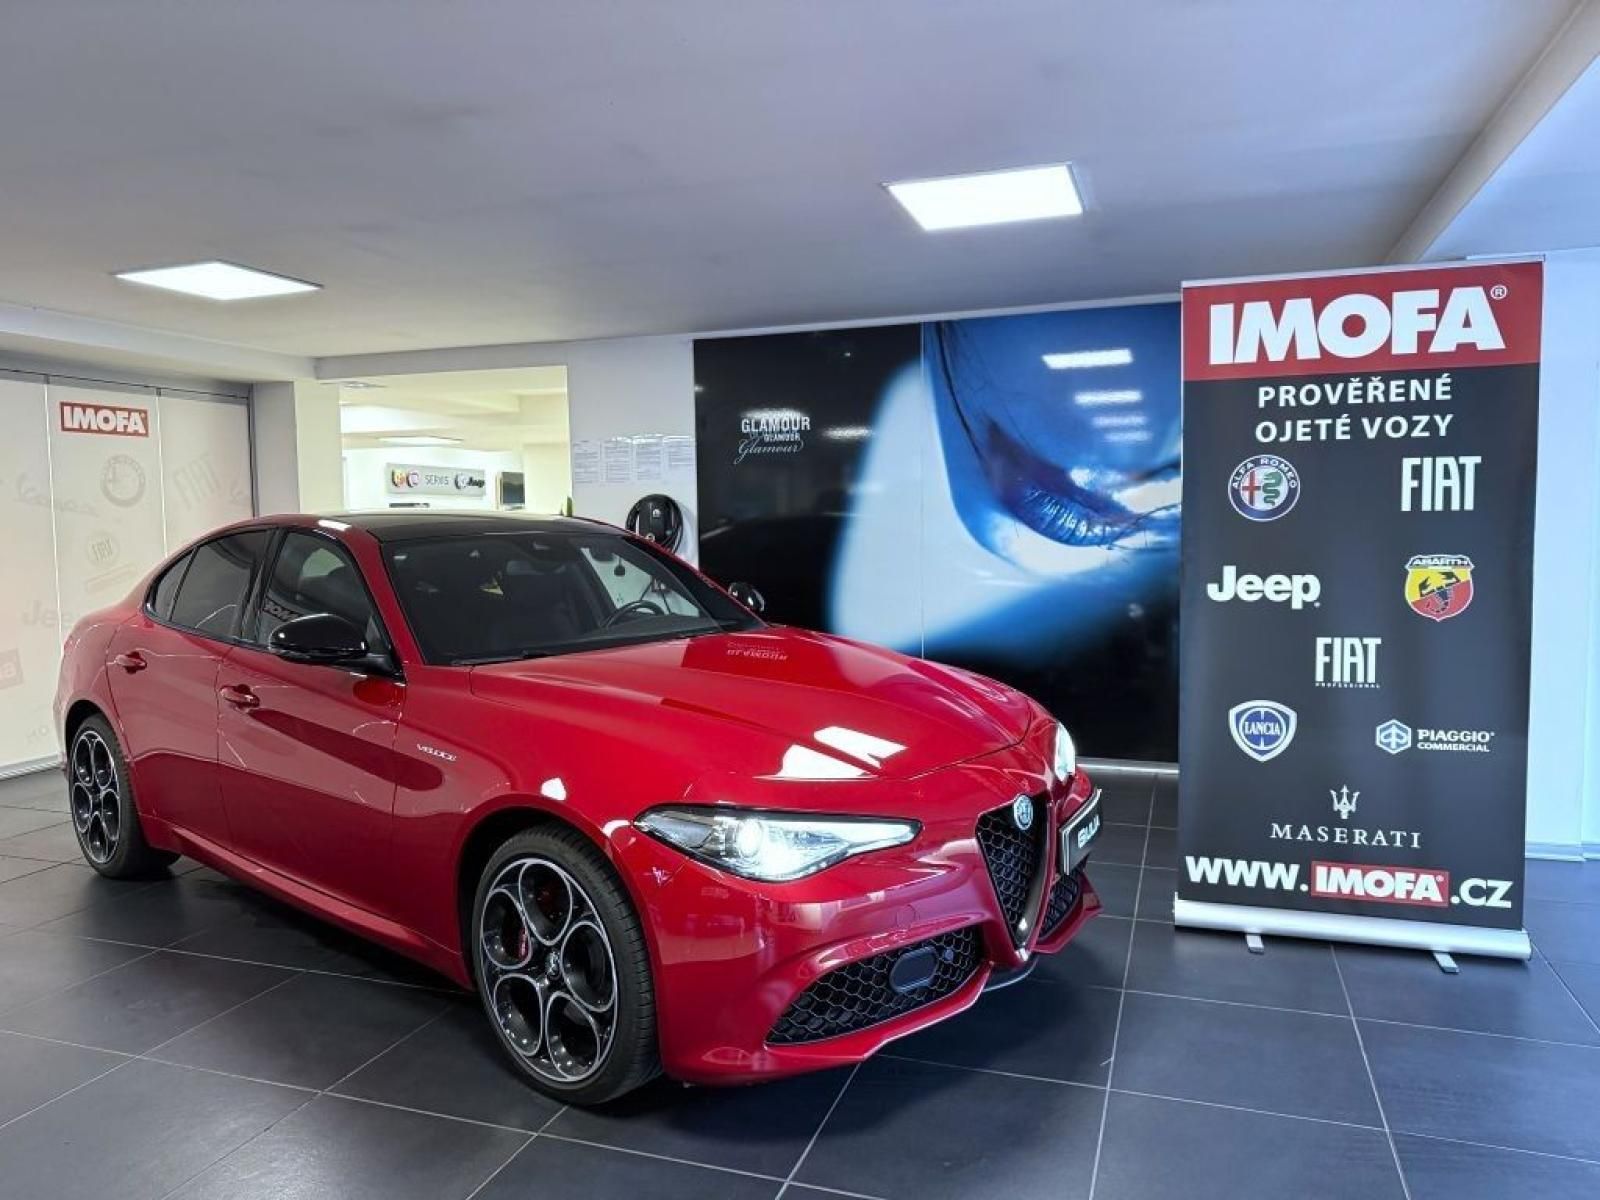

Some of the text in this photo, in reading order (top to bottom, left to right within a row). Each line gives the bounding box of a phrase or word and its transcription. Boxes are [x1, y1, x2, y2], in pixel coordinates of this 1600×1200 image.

[1257, 373, 1453, 408] PROVĚŘENÉ
[63, 406, 147, 434] IMOFA
[741, 416, 811, 433] GLAMOUR
[1255, 413, 1454, 444] OJETÉ VOZY
[1232, 458, 1297, 489] ALFA ROMEO
[1400, 456, 1482, 512] FIAT
[1207, 565, 1321, 609] Jeep
[1315, 637, 1382, 683] FIAT
[1244, 721, 1281, 736] LANCIA
[1416, 729, 1492, 743] PIAGGIO
[1416, 742, 1491, 753] COMMERCIAL
[1269, 823, 1422, 848] MASERATI
